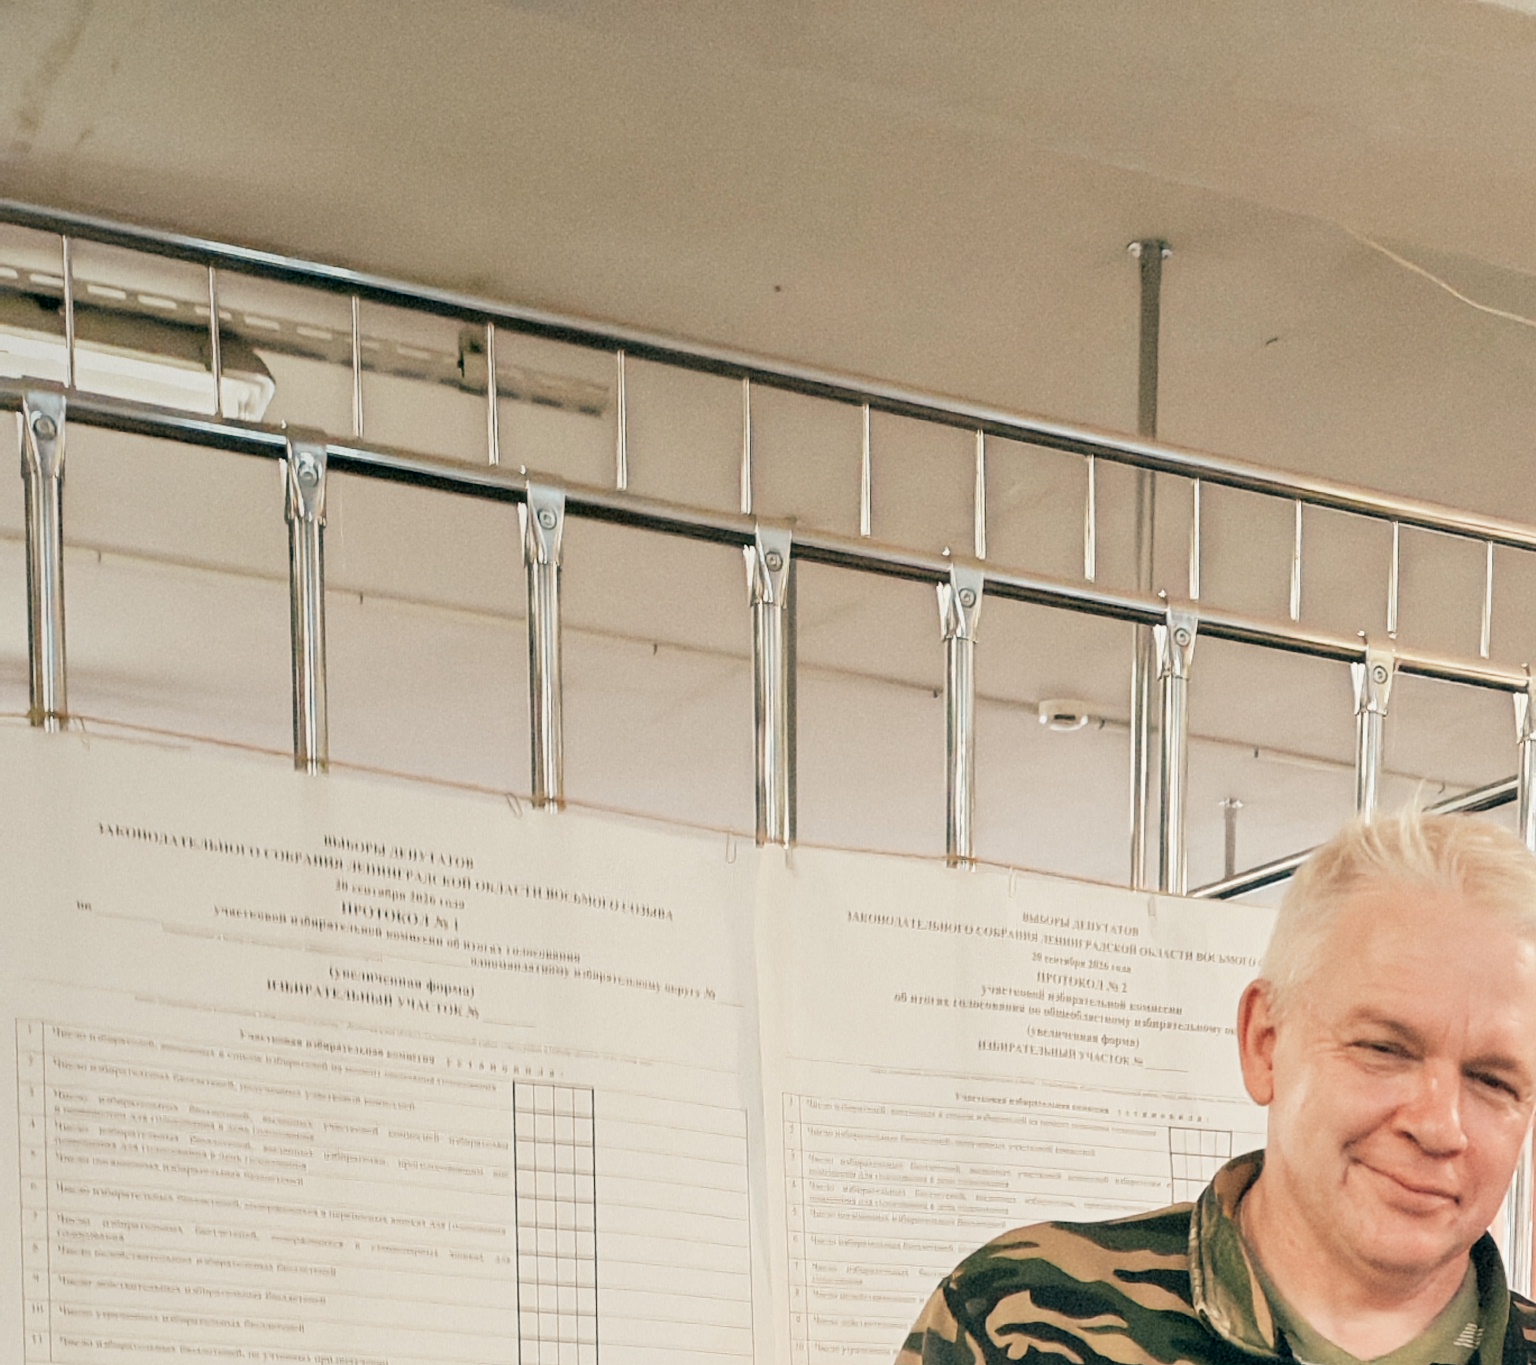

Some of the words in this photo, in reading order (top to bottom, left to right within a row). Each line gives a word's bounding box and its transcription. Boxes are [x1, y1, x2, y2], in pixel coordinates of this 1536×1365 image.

[324, 833, 385, 857] ВЫБОРЫ
[389, 843, 474, 871] ДЕПУТАТОВ
[341, 899, 429, 928] ПРОТОКОЛ
[1022, 911, 1069, 929] ВЫБОРЫ
[1073, 917, 1138, 938] ДЕПУТАТОВ
[847, 908, 973, 935] ЗАКОНОДАТЕЛЬНОГО
[975, 923, 1038, 943] СОБРАНИЯ
[1040, 932, 1136, 957] ЛЕНИНГРАДСКОЙ
[1139, 944, 1192, 962] ОБЛАСТИ
[1196, 950, 1255, 969] ВОСЬМОГО
[1036, 971, 1104, 991] ПРОТОКОЛ
[1108, 979, 1119, 992] №
[1121, 980, 1127, 993] 2
[978, 1037, 1077, 1061] ИЗБИРАТЕЛЬНЫЙ
[1079, 1047, 1130, 1066] УЧАСТОК
[1133, 1055, 1144, 1066] №
[1026, 1024, 1098, 1046] (увеличенная
[1101, 1032, 1140, 1051] форма)
